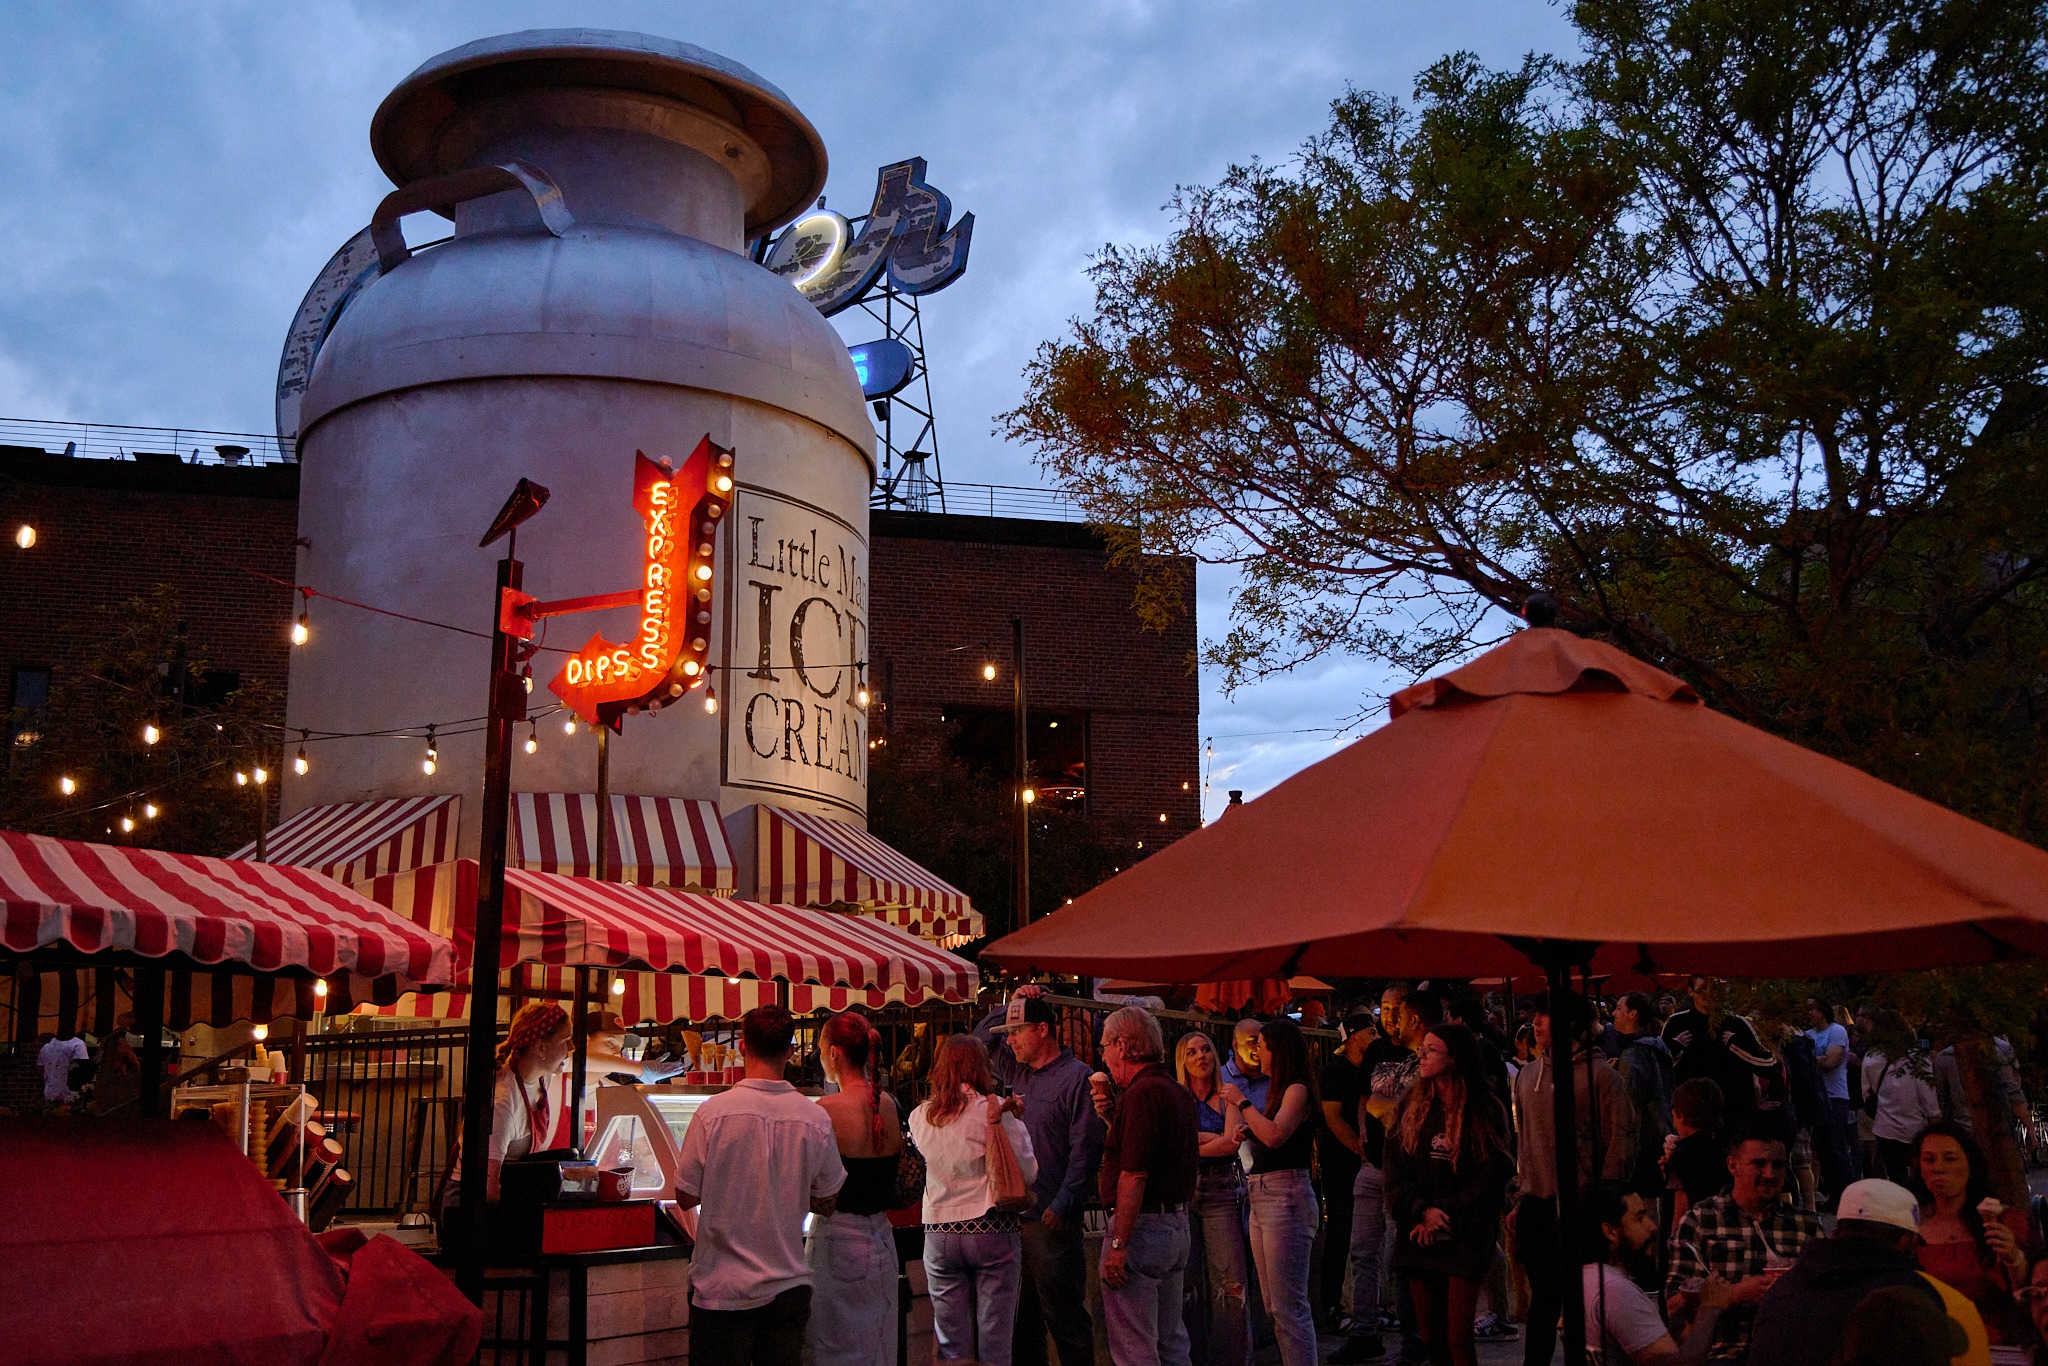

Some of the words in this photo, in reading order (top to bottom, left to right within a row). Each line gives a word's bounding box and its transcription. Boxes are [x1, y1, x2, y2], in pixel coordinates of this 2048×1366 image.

[642, 481, 674, 670] EXPRESS
[747, 515, 830, 588] Little
[566, 649, 633, 686] DIPS
[747, 579, 868, 716] ICE
